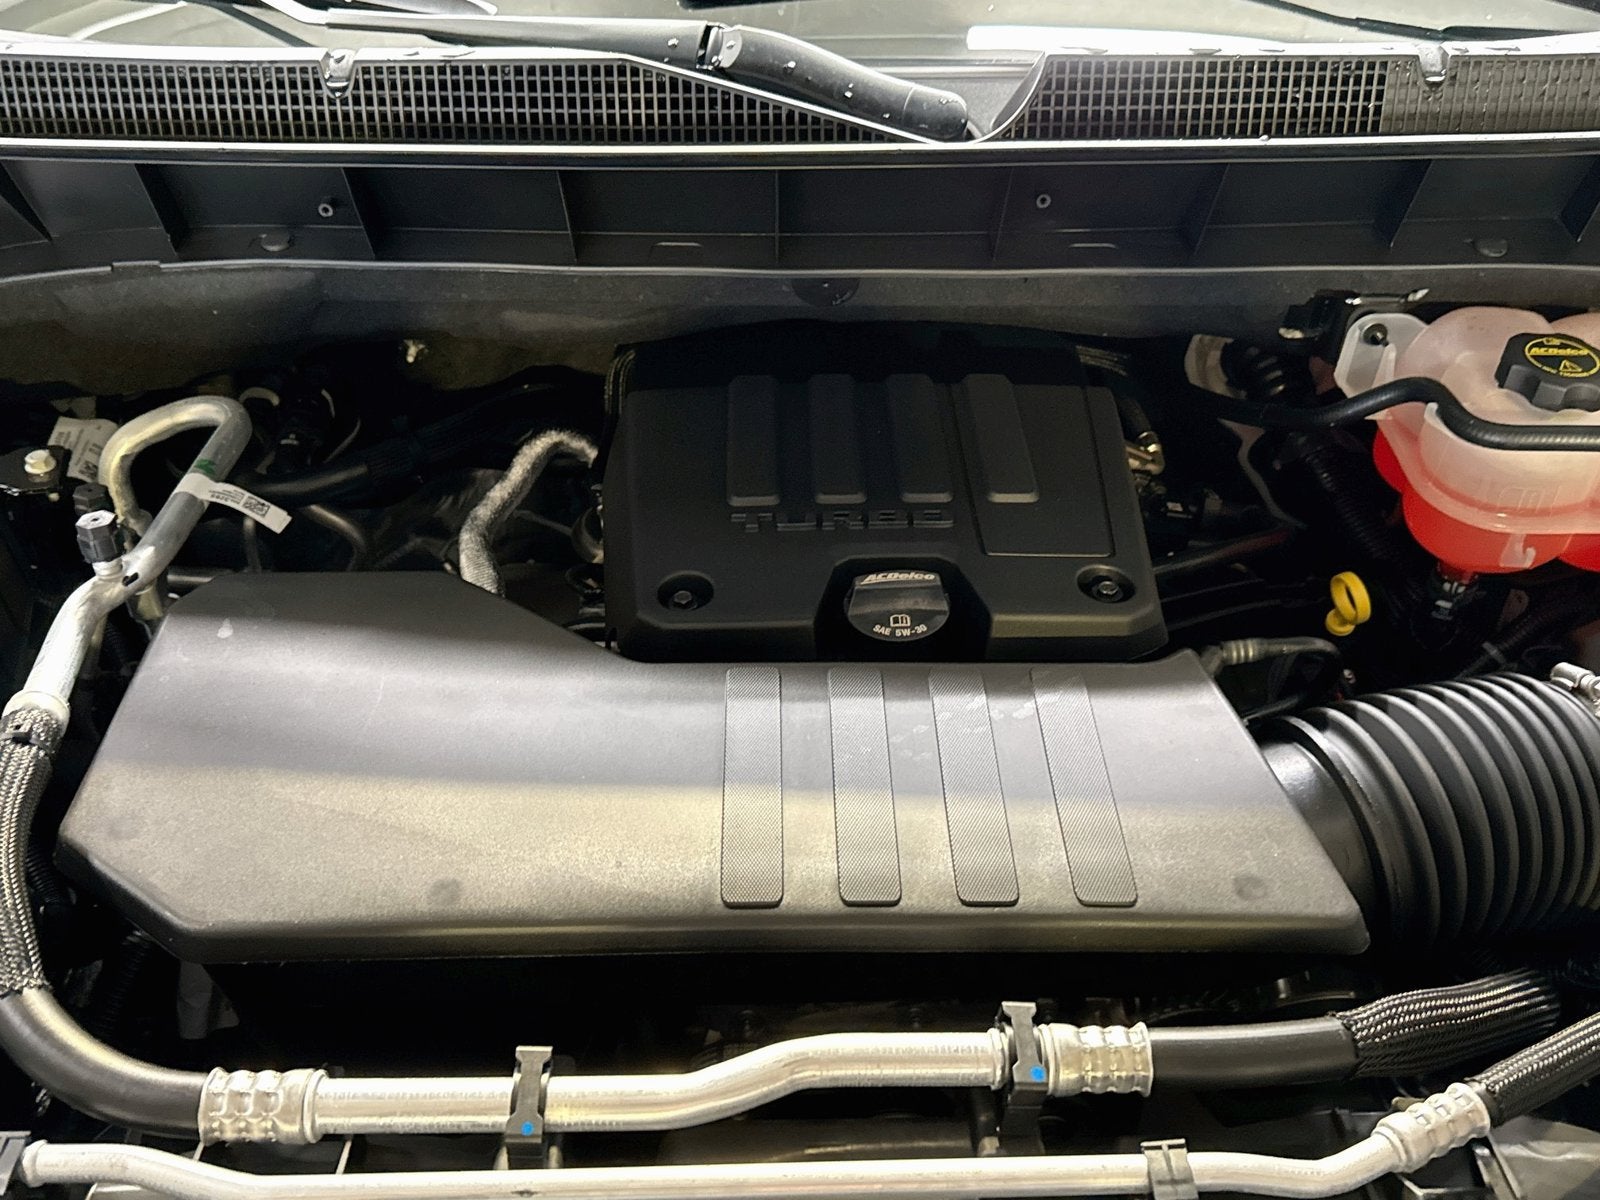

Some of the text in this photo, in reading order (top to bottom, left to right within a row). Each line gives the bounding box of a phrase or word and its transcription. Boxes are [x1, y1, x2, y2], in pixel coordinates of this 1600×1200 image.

[730, 508, 954, 533] TURBO
[861, 572, 935, 583] ACDelco
[873, 624, 928, 637] SAE 5W-30
